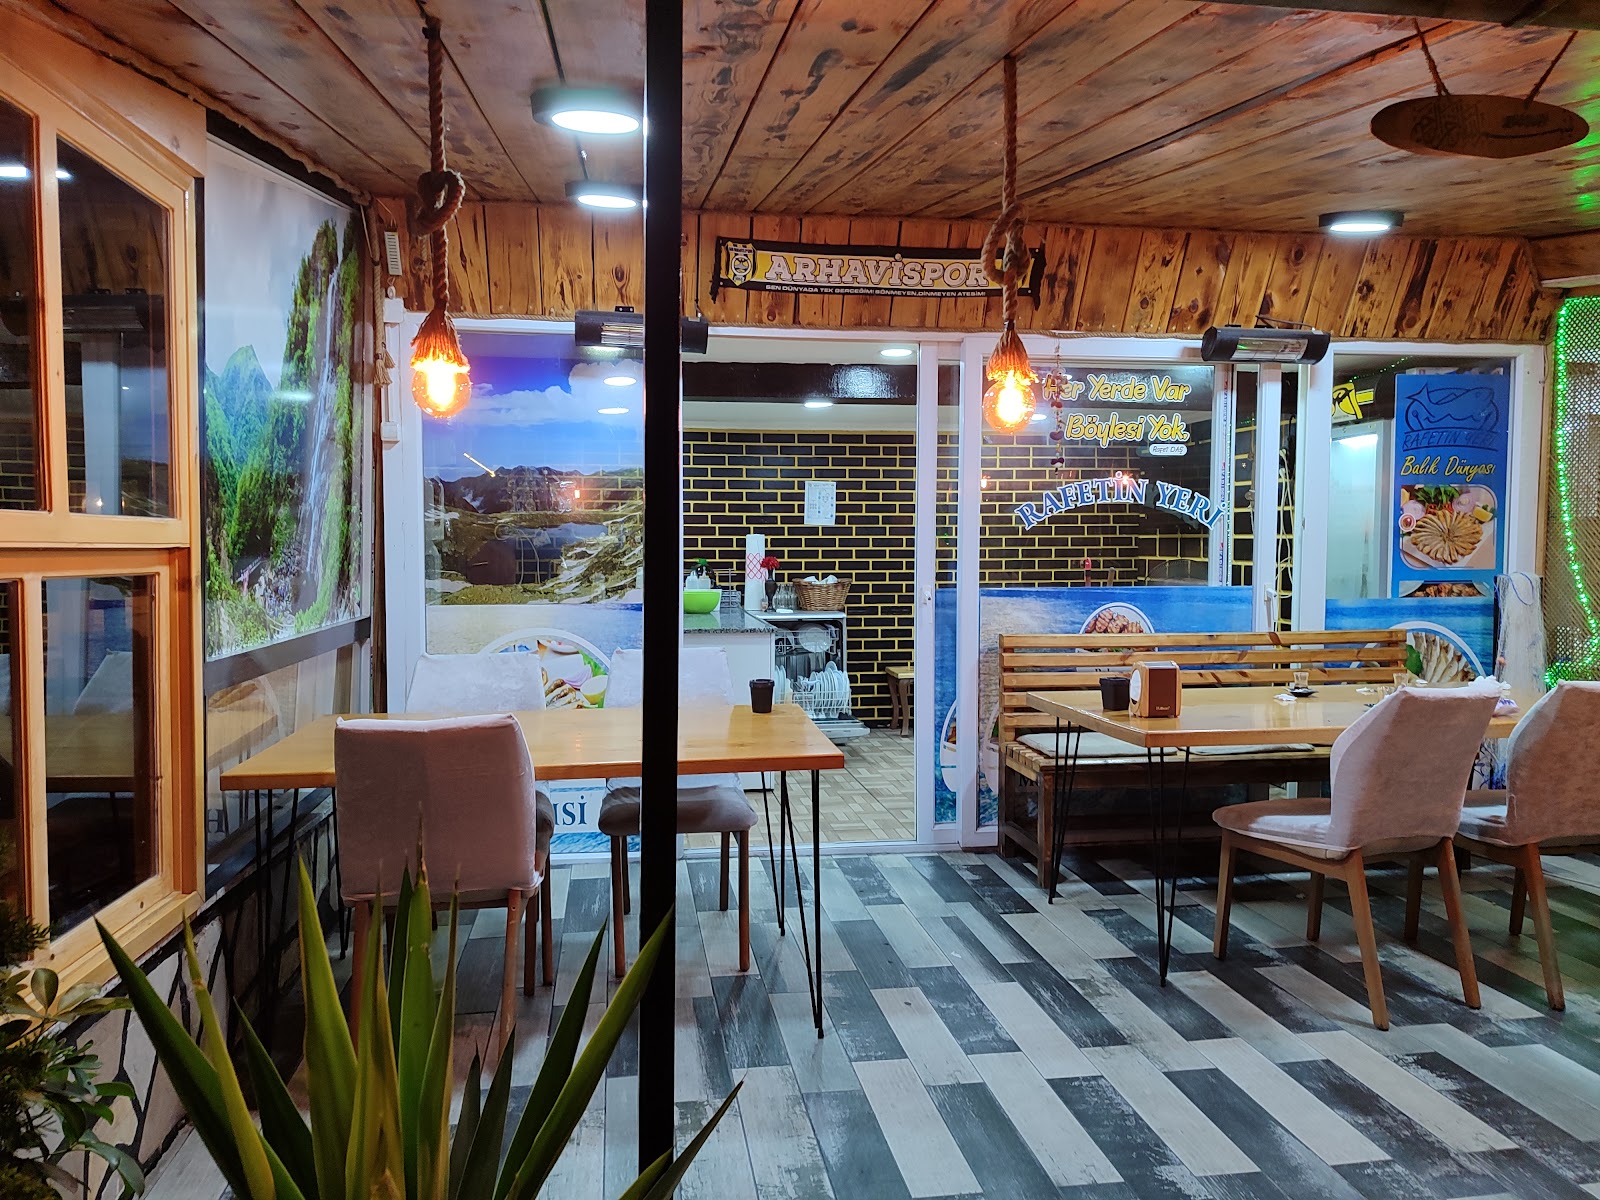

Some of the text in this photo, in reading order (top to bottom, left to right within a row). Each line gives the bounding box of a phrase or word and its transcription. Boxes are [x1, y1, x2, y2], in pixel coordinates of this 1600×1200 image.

[765, 253, 989, 287] ARHAVİSPOR
[782, 285, 819, 293] DÜNYADA
[1088, 374, 1148, 400] Yerde
[1152, 376, 1191, 401] Var
[1066, 413, 1147, 448] Böylesi
[1400, 455, 1496, 482] Balık Dünyası
[1015, 471, 1149, 530] RAFETİN
[1156, 481, 1229, 530] YERİ
